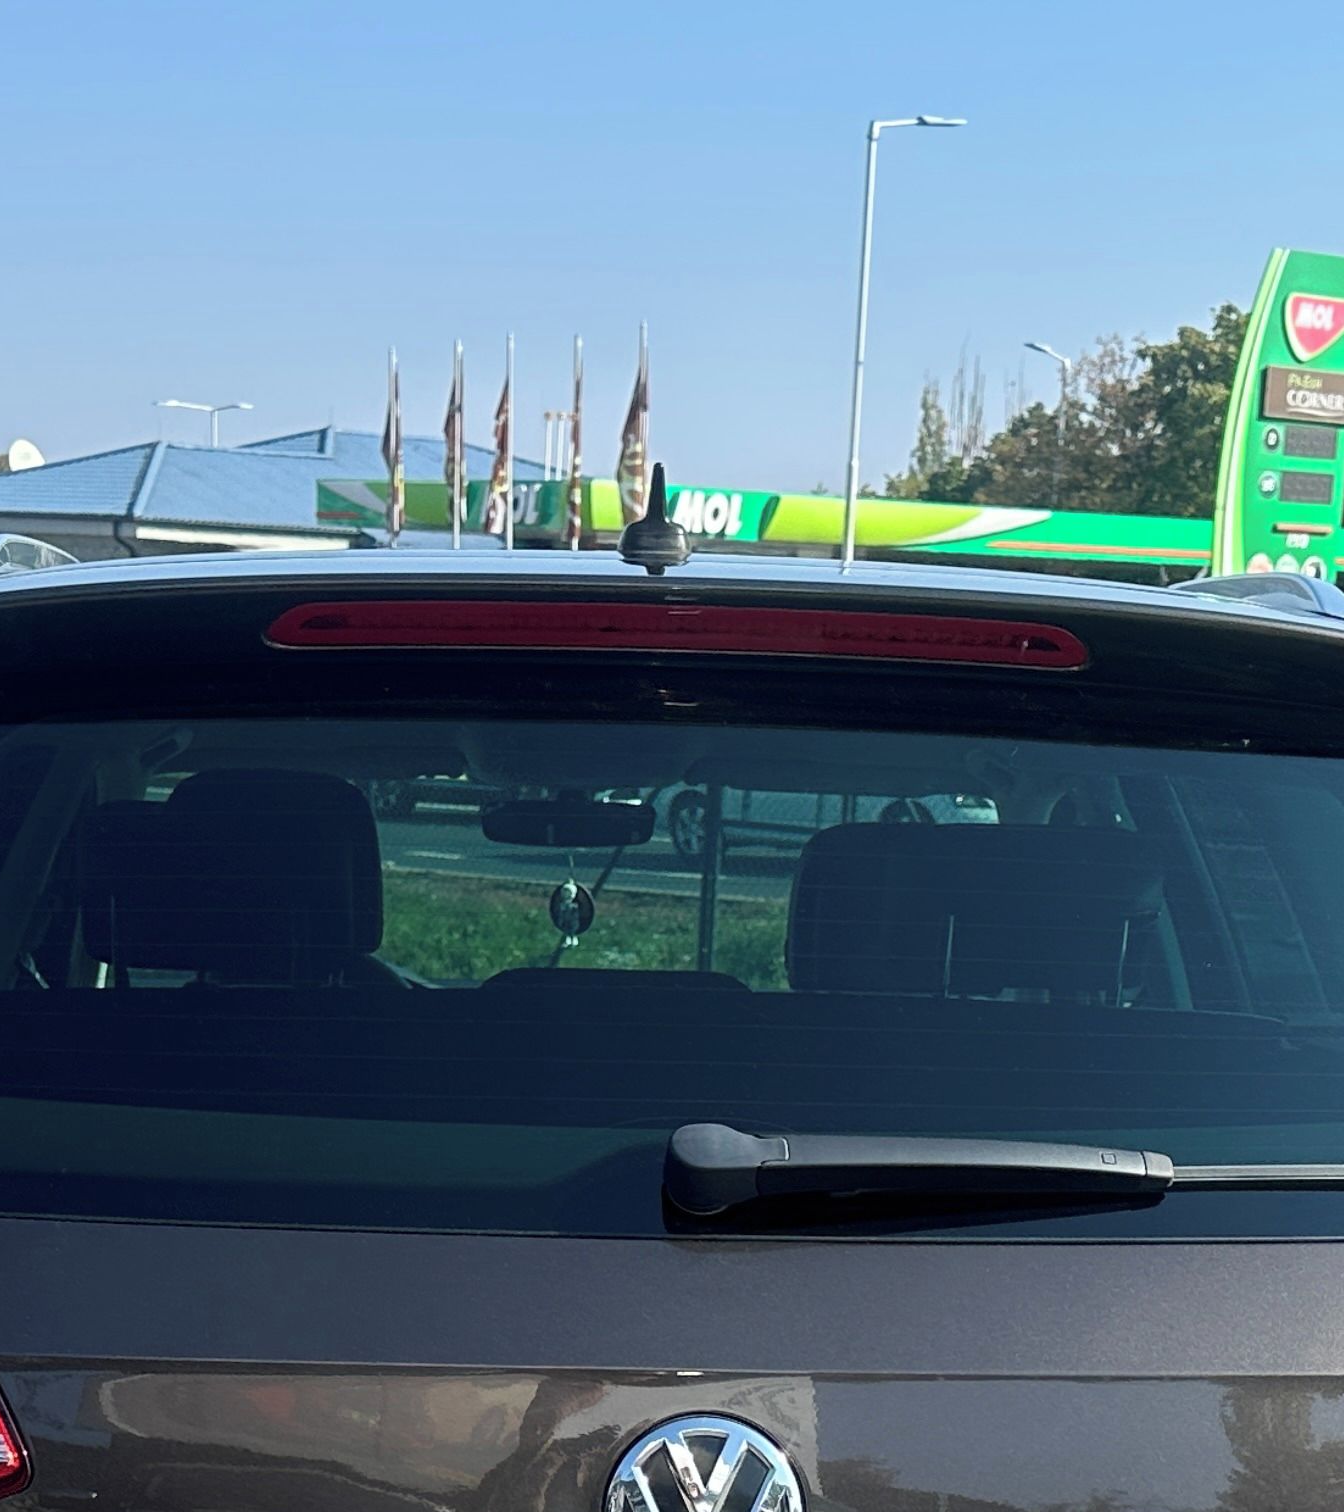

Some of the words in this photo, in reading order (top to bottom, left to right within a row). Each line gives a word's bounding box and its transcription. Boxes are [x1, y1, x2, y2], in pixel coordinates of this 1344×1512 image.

[1295, 302, 1334, 331] MOL
[1286, 389, 1344, 410] CORNER
[673, 489, 744, 535] MOL
